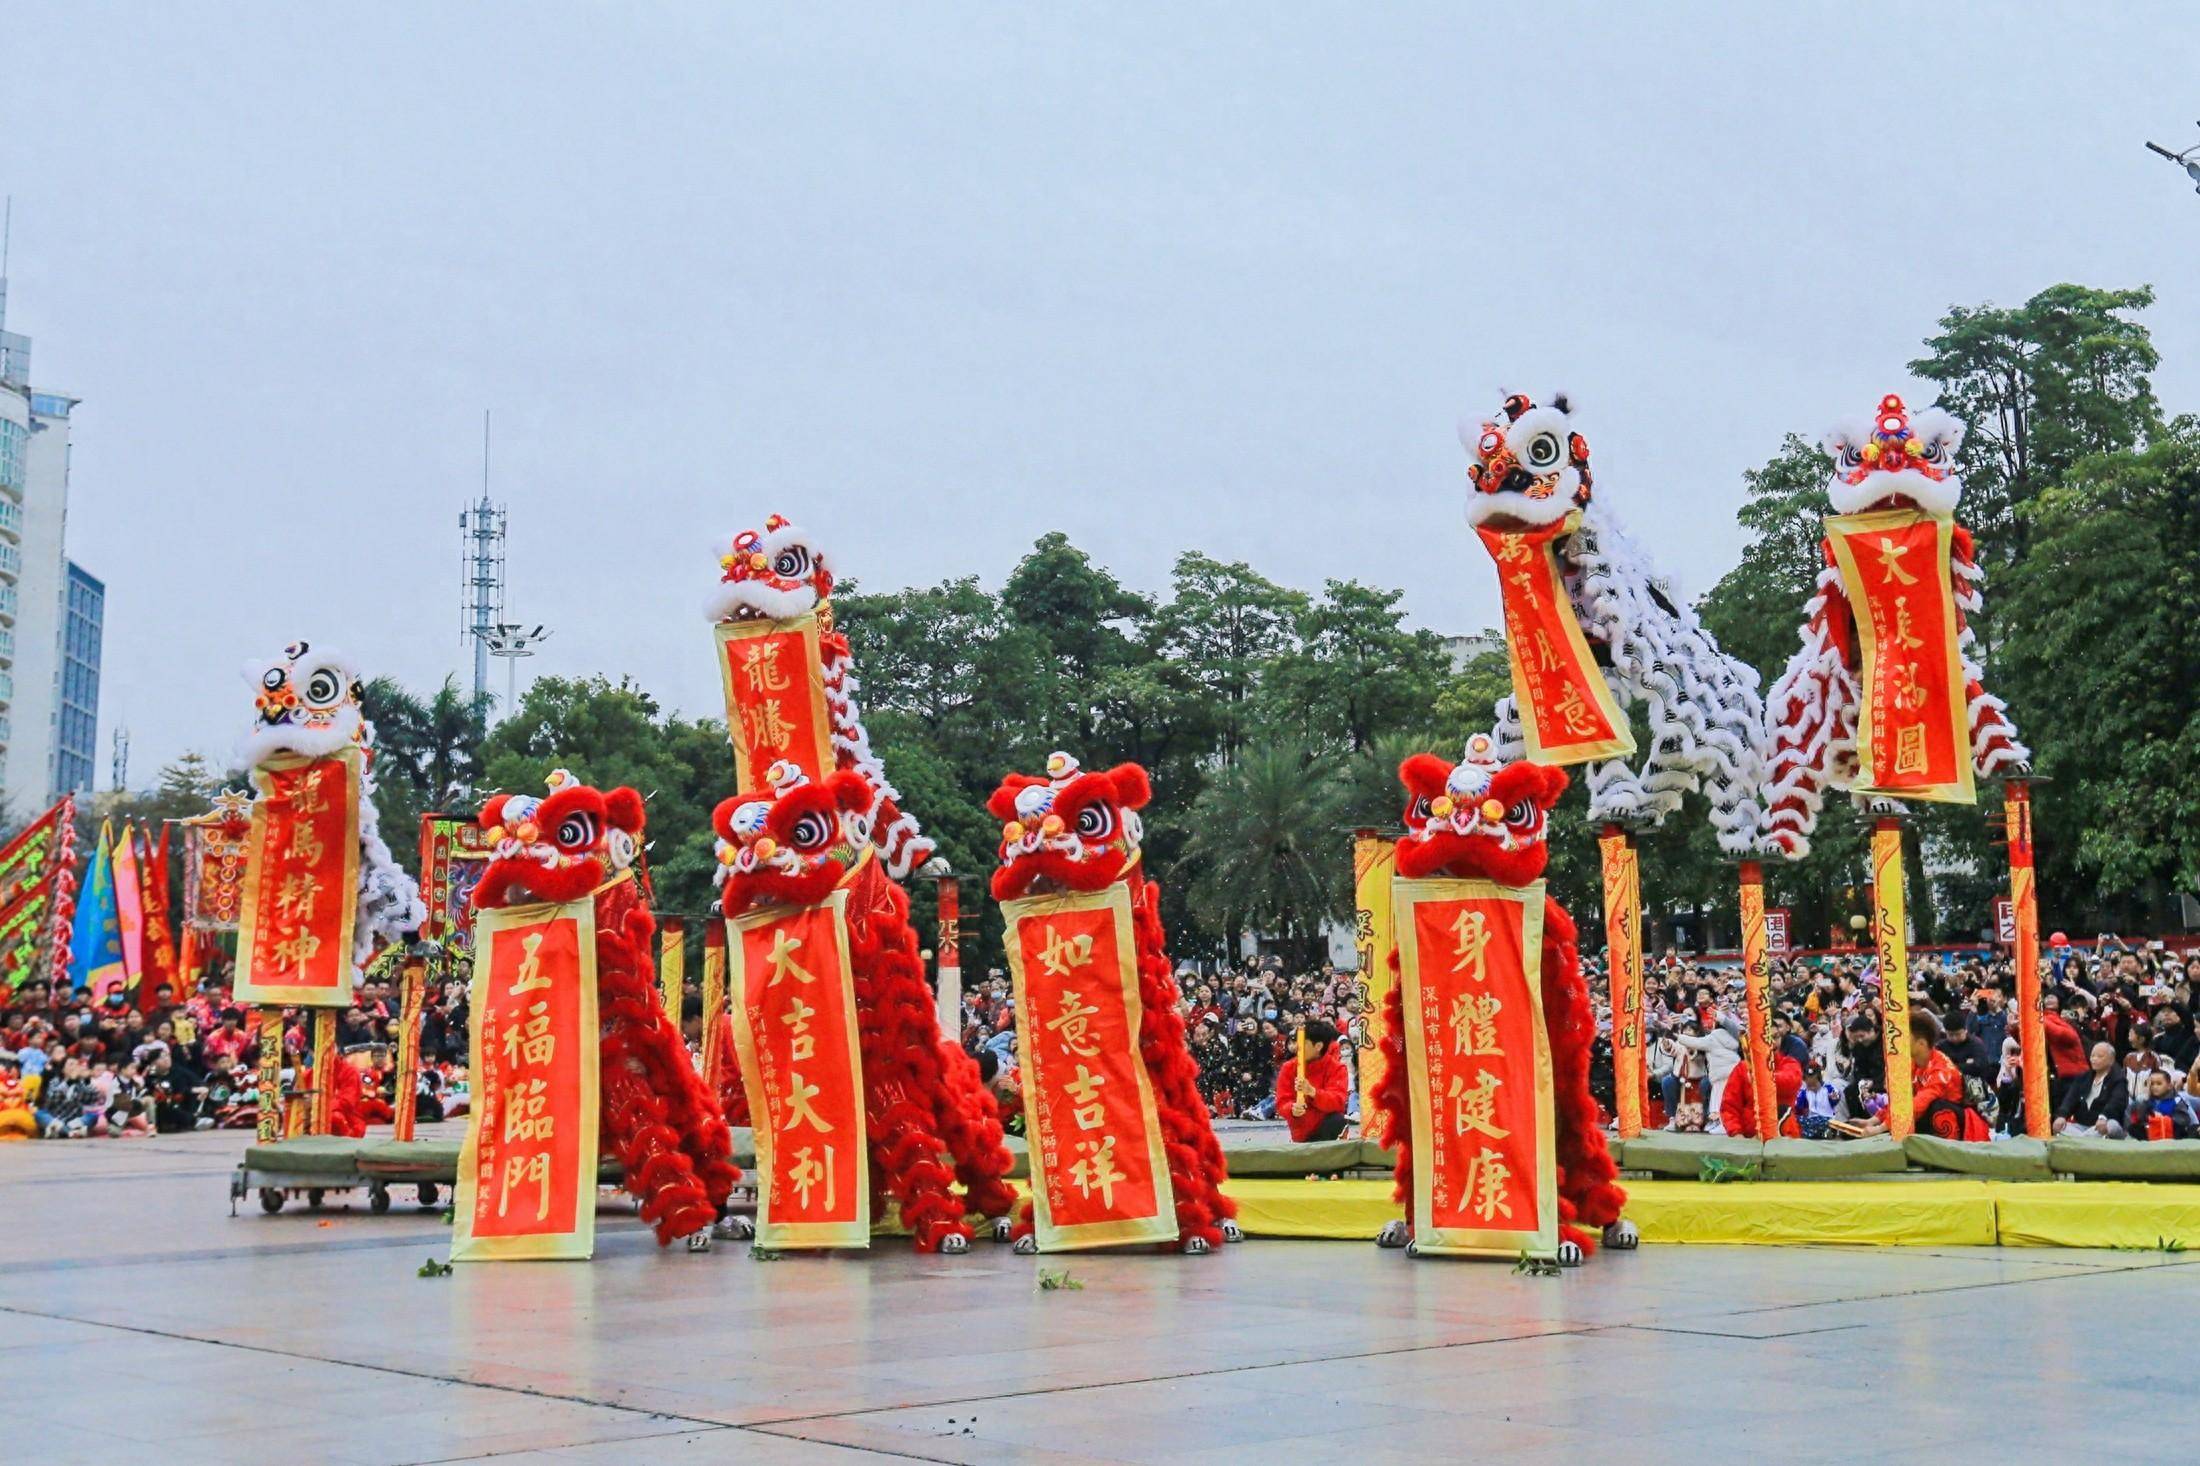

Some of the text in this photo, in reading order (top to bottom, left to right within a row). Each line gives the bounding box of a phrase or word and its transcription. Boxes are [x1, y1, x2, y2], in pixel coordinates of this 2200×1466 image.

[272, 770, 330, 980] 龍馬精神
[498, 932, 556, 1221] 五福臨門
[766, 928, 835, 1213] 大吉大利
[1037, 924, 1128, 1210] 如意吉祥
[1447, 909, 1513, 1222] 身體健康
